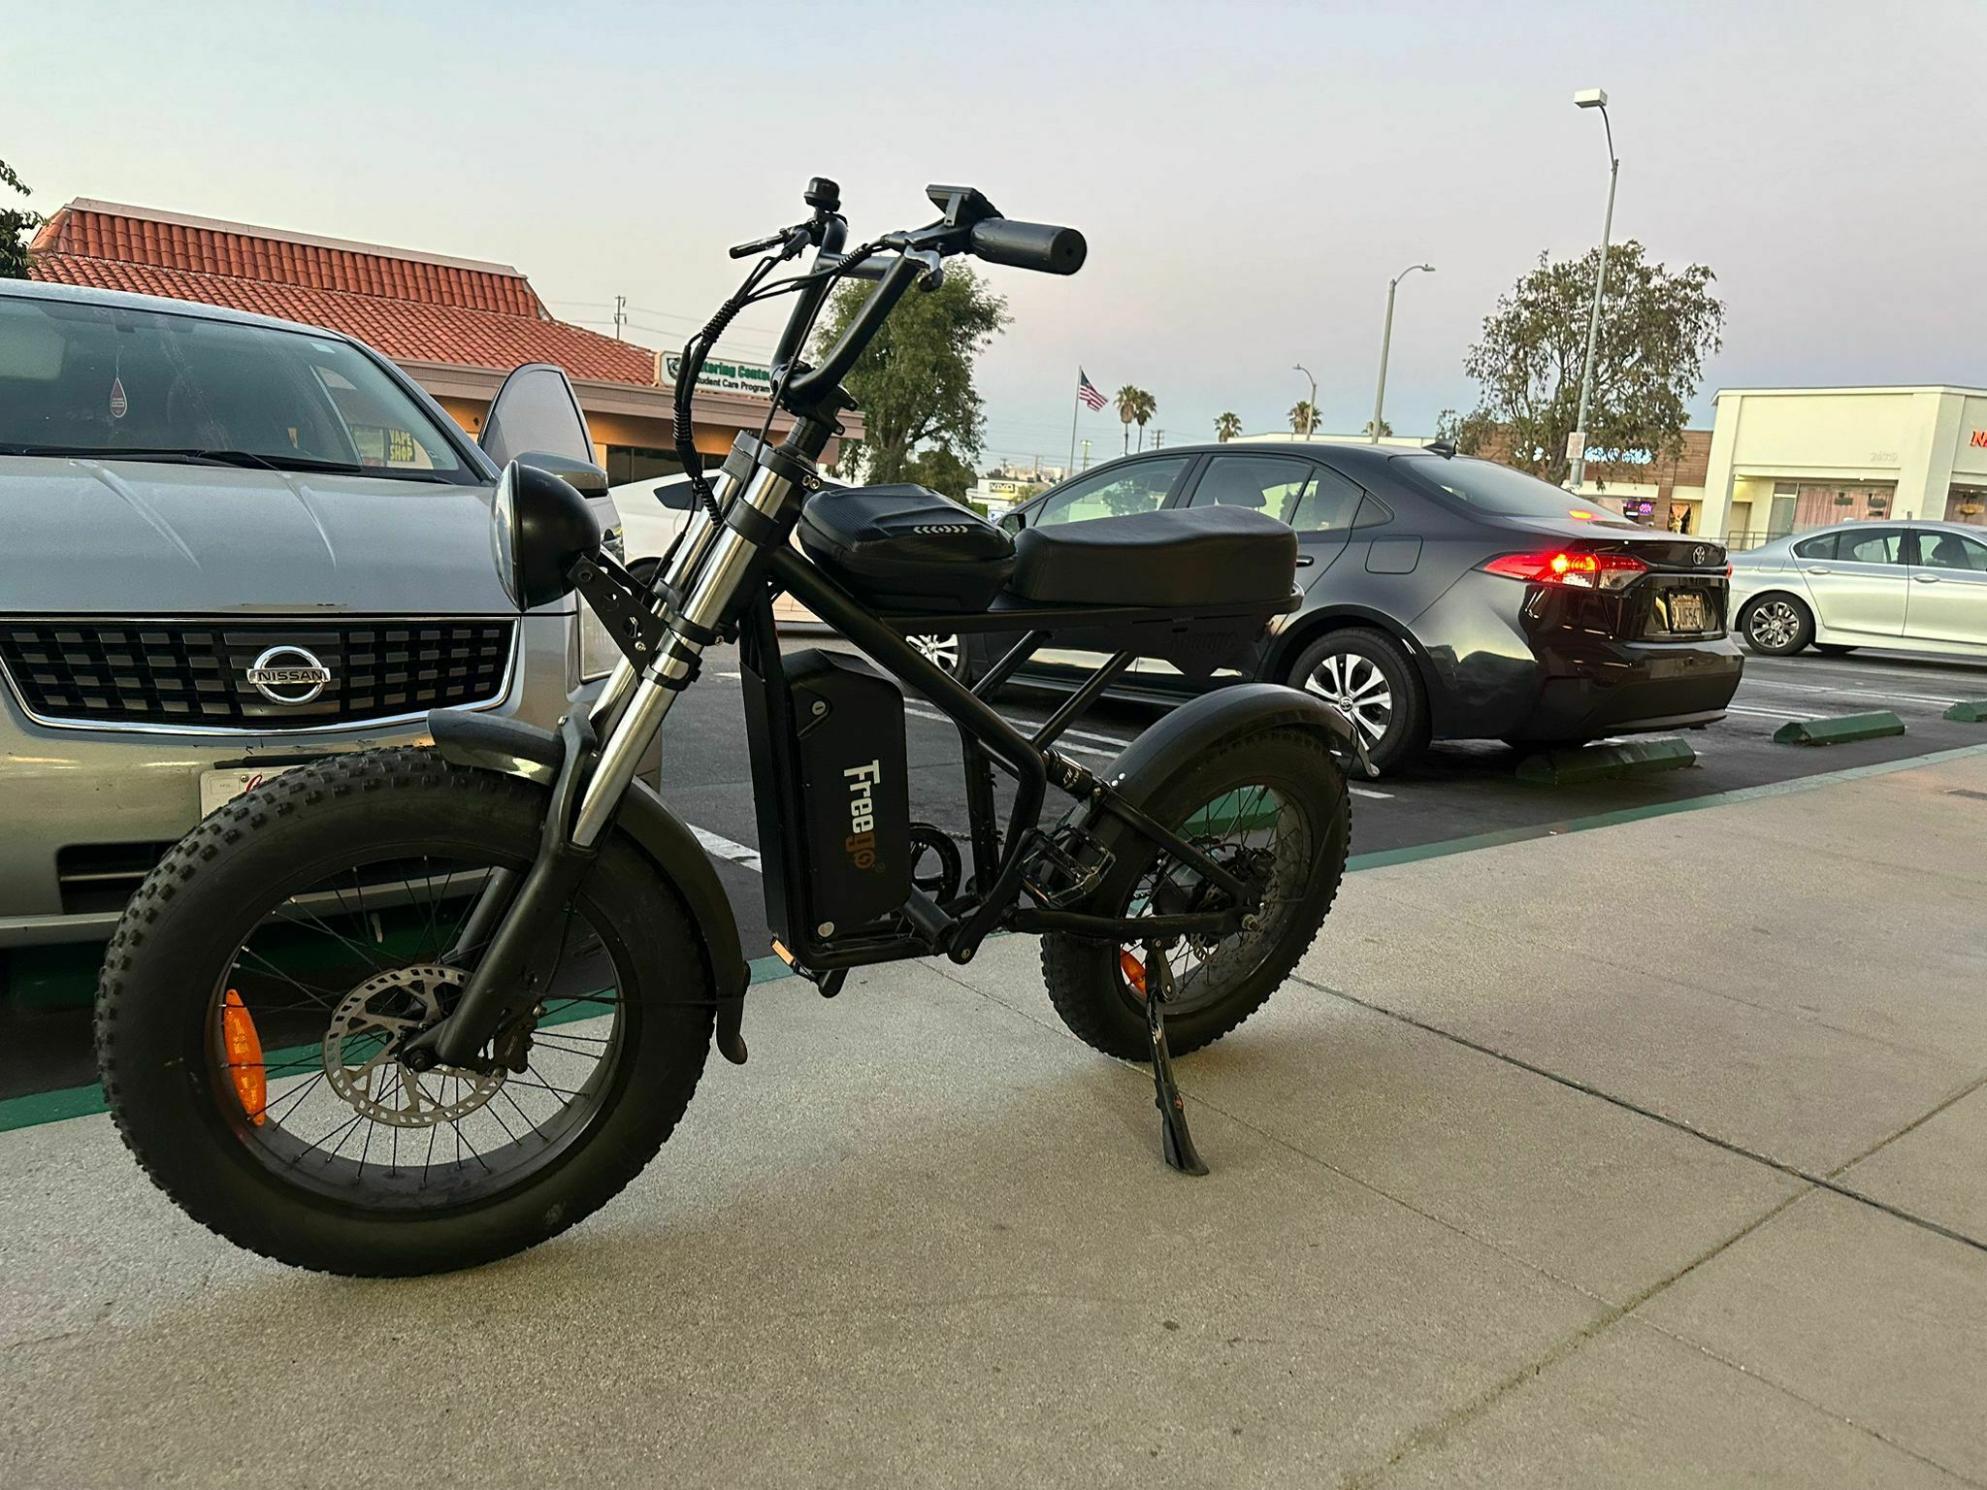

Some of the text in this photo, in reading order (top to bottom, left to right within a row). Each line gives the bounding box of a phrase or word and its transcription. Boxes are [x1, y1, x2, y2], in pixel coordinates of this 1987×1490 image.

[701, 361, 737, 378] toring
[722, 379, 739, 389] Care
[389, 428, 412, 446] VAPE
[390, 444, 413, 461] SHOP
[257, 670, 323, 681] NISSAN
[843, 759, 881, 869] Freego
